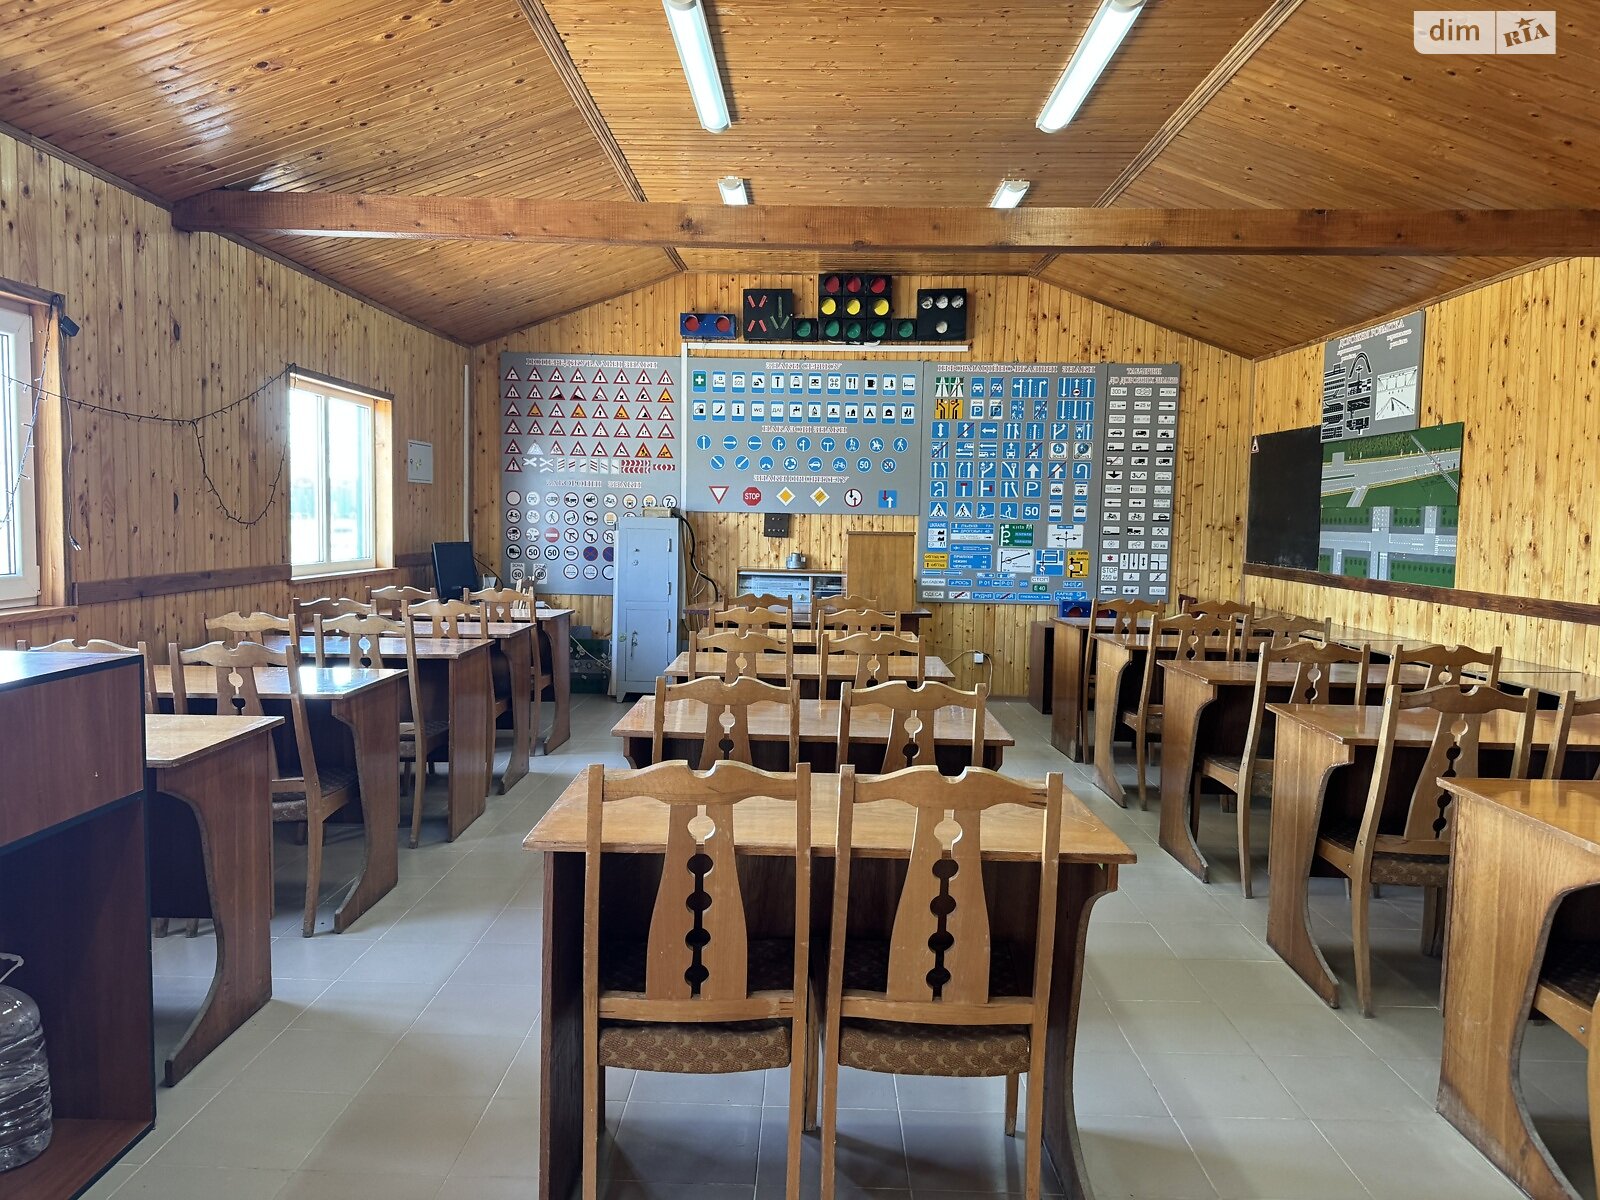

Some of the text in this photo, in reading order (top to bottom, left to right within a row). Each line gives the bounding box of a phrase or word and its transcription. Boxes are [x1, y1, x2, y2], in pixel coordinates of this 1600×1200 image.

[859, 461, 869, 469] 50
[1026, 481, 1039, 497] P
[744, 492, 761, 500] STOP
[1024, 506, 1039, 516] 50
[528, 548, 538, 556] 50
[547, 549, 557, 557] 50
